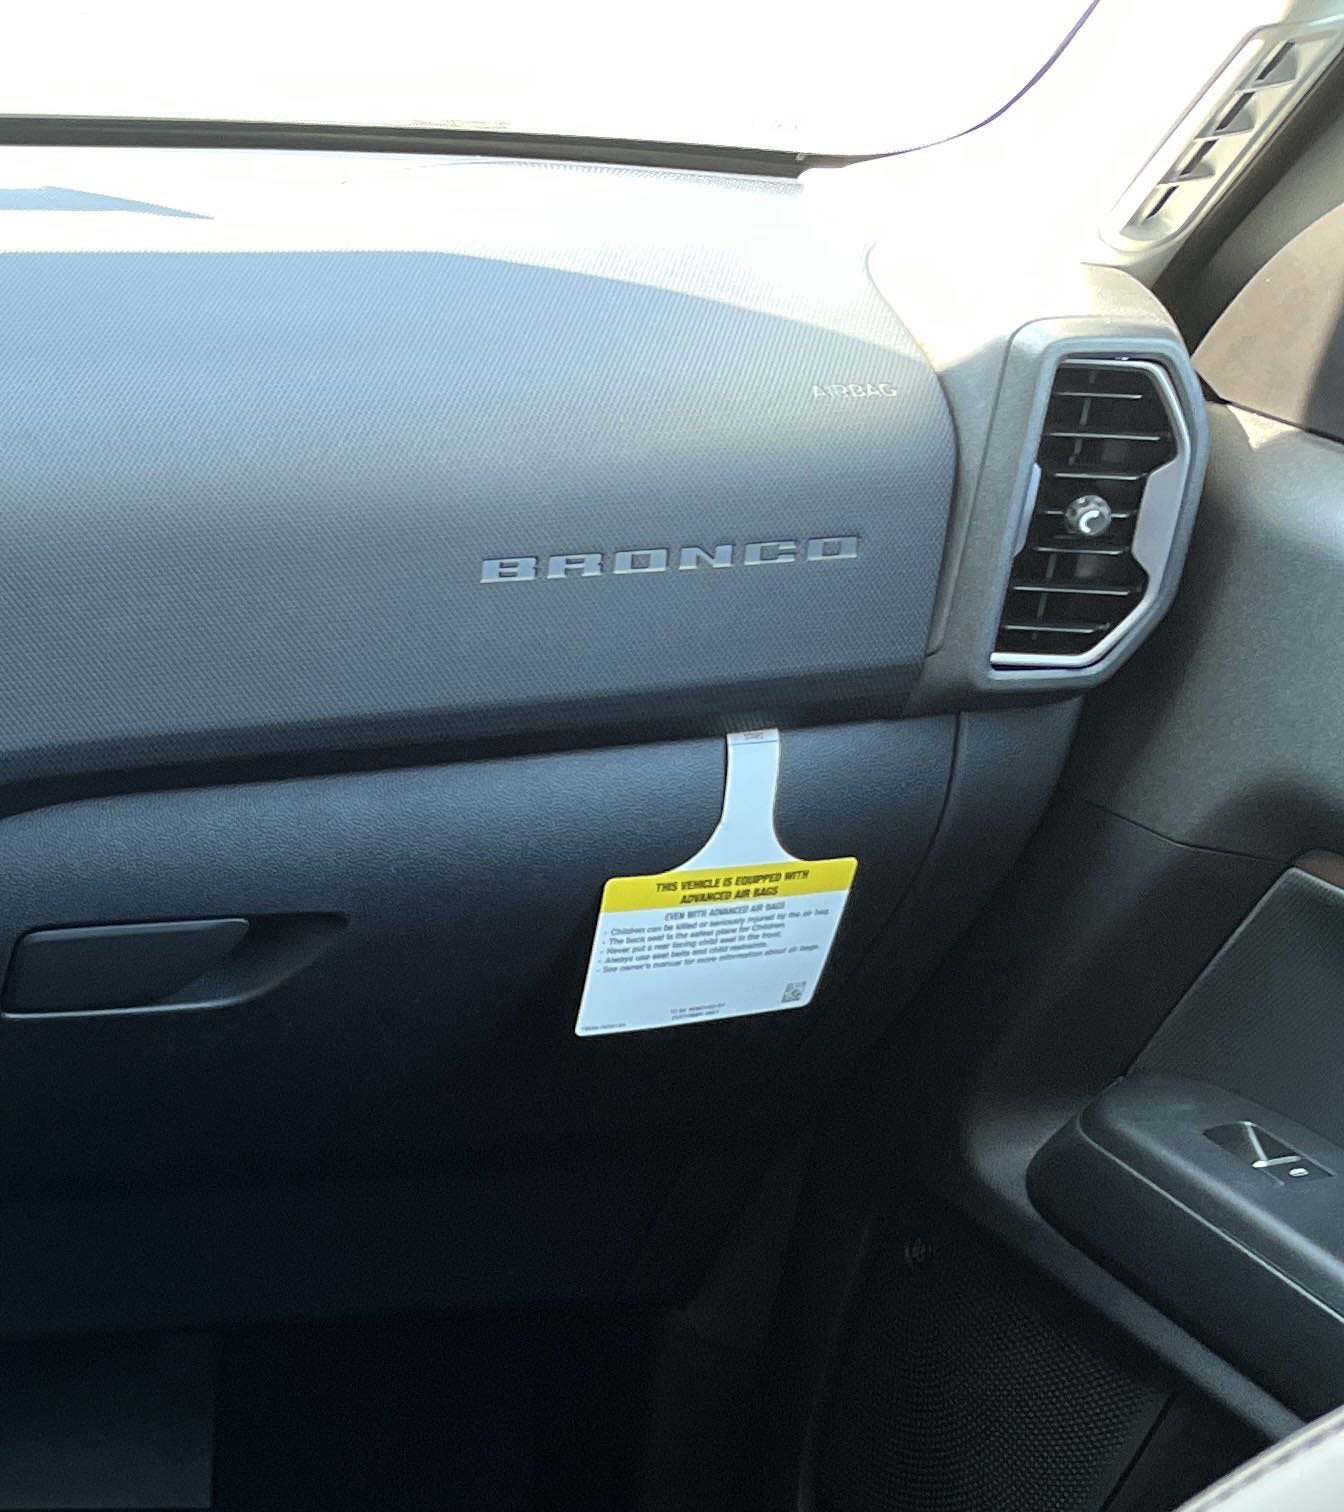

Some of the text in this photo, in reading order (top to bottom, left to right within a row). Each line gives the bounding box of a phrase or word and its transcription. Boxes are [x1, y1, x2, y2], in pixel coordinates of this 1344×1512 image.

[812, 382, 898, 400] AIRBAG
[480, 533, 860, 584] BRONCO
[656, 869, 810, 892] THIS VEHICLE IS EQUIPPED WITH
[680, 886, 779, 904] ADVANCED AIR BAGS
